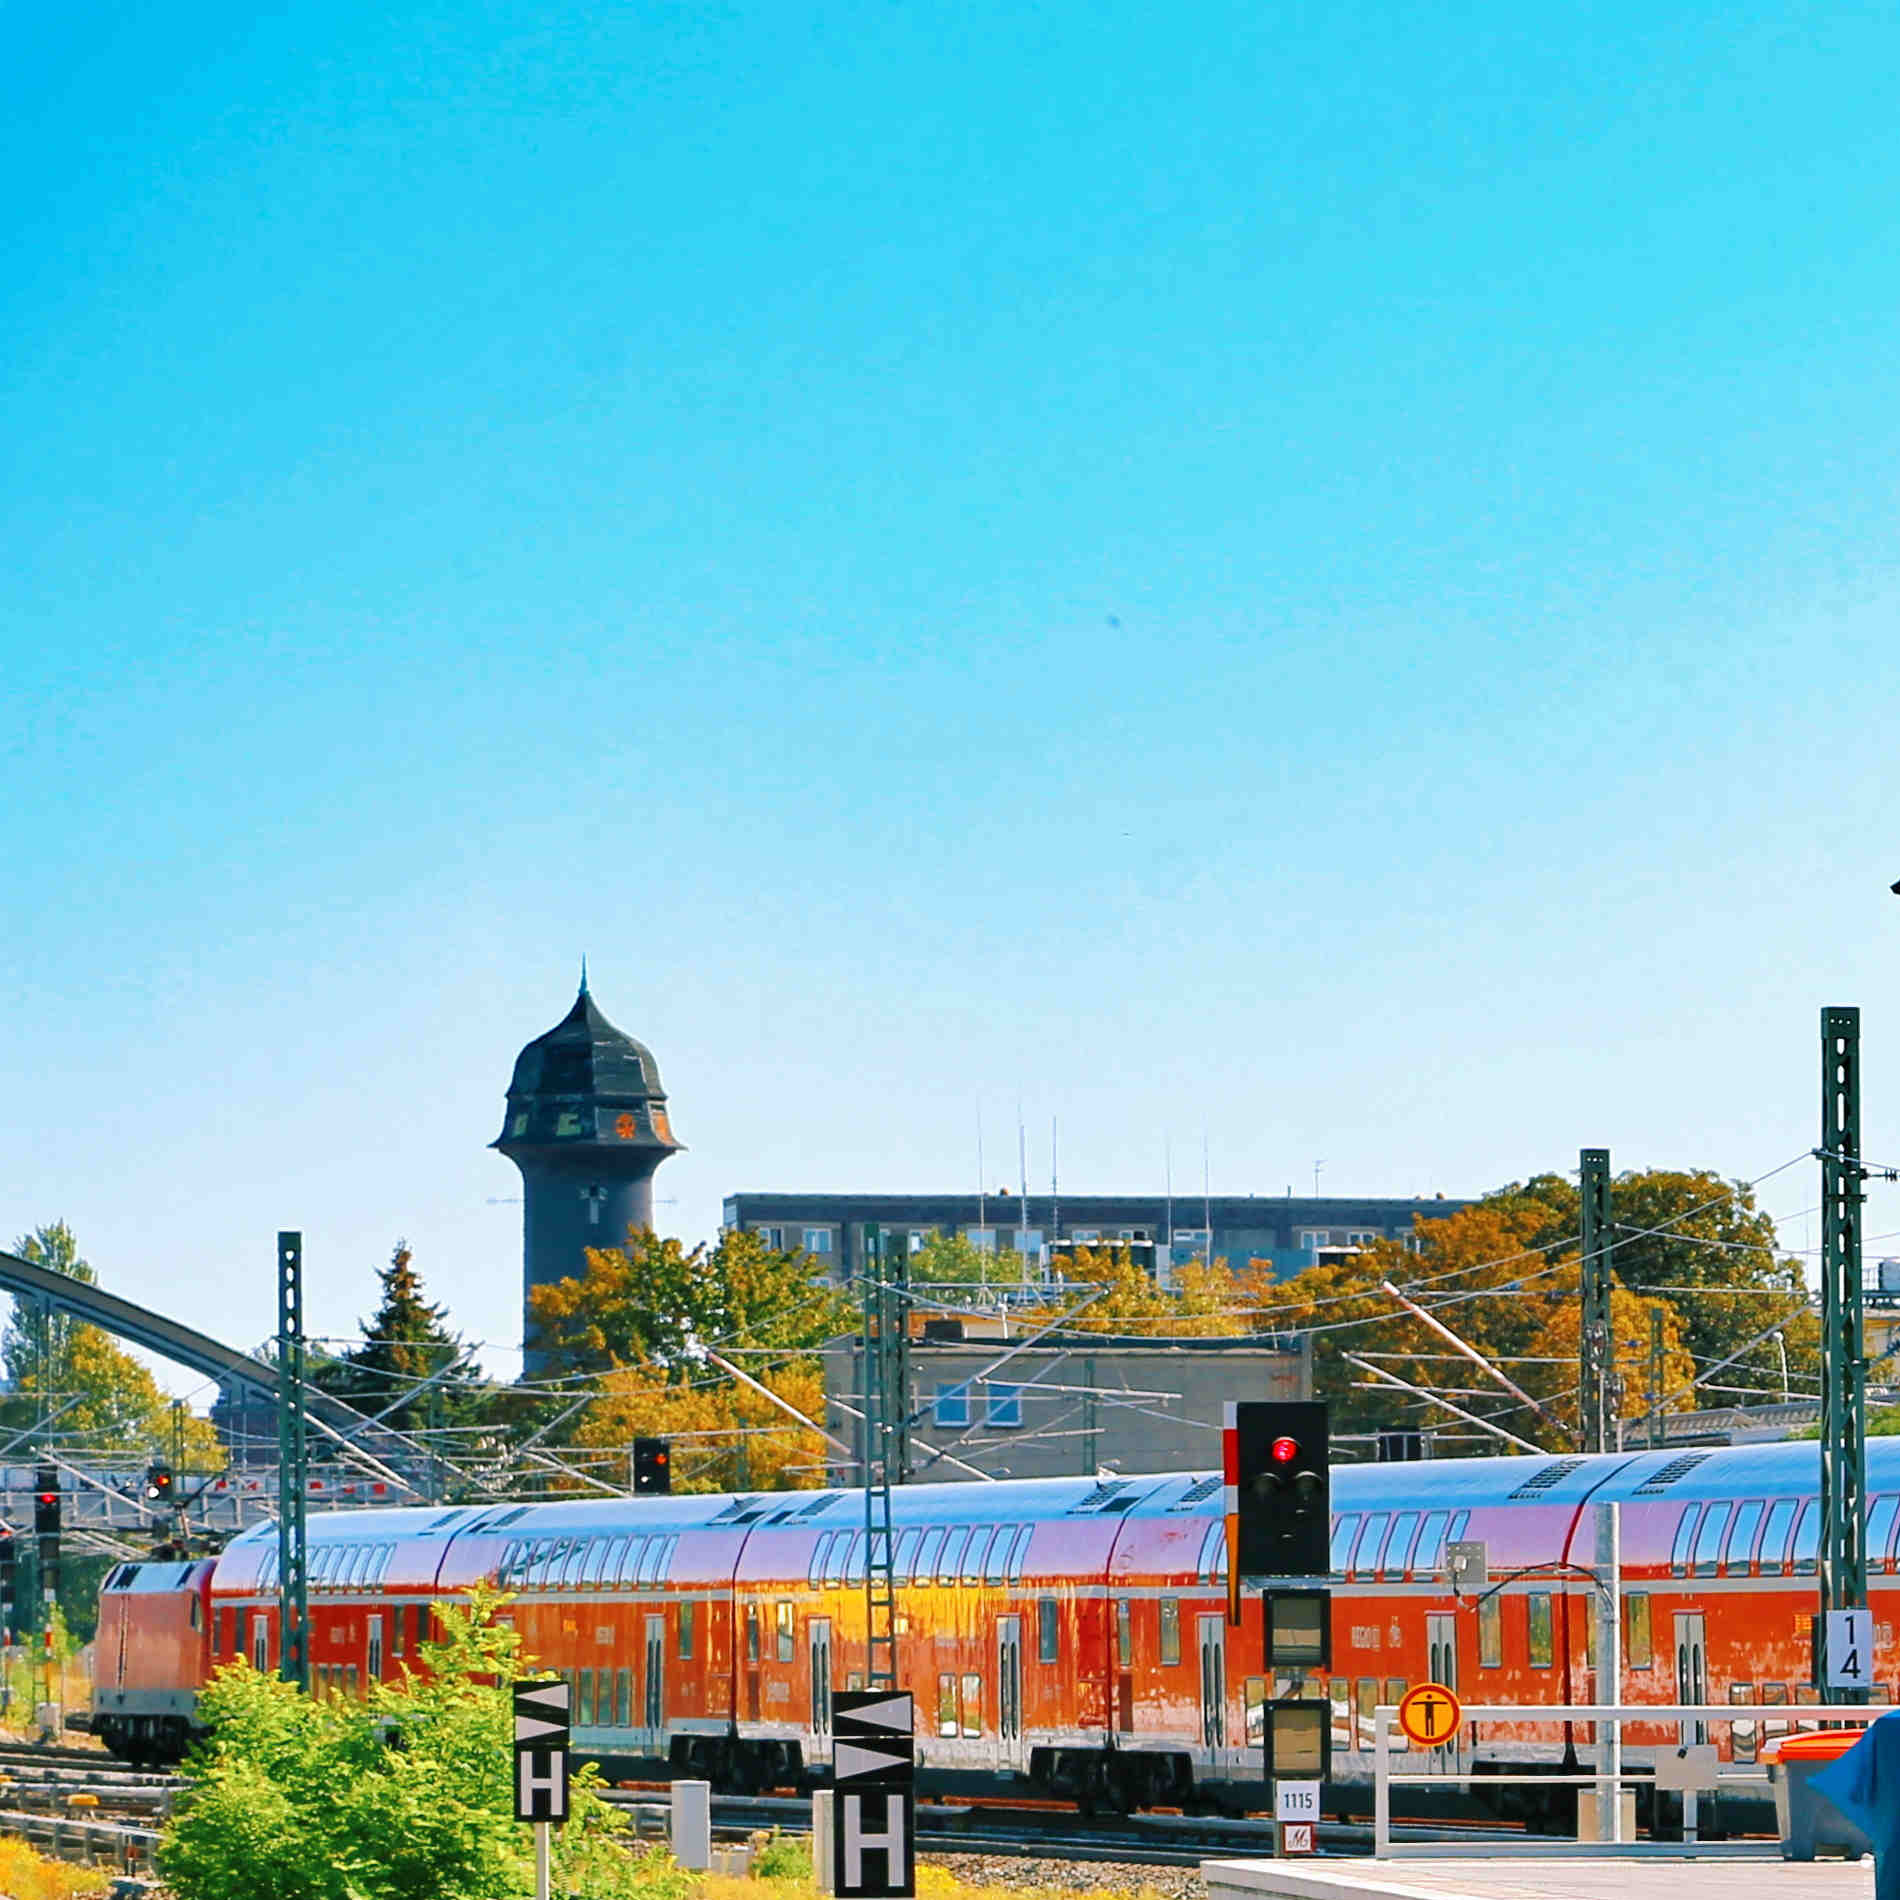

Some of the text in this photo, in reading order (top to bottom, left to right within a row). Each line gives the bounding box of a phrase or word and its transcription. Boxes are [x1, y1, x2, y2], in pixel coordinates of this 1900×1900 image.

[1845, 1615, 1855, 1645] 1
[1840, 1649, 1861, 1679] 4
[520, 1751, 563, 1815] H
[1284, 1792, 1313, 1809] 1115
[844, 1795, 905, 1887] H
